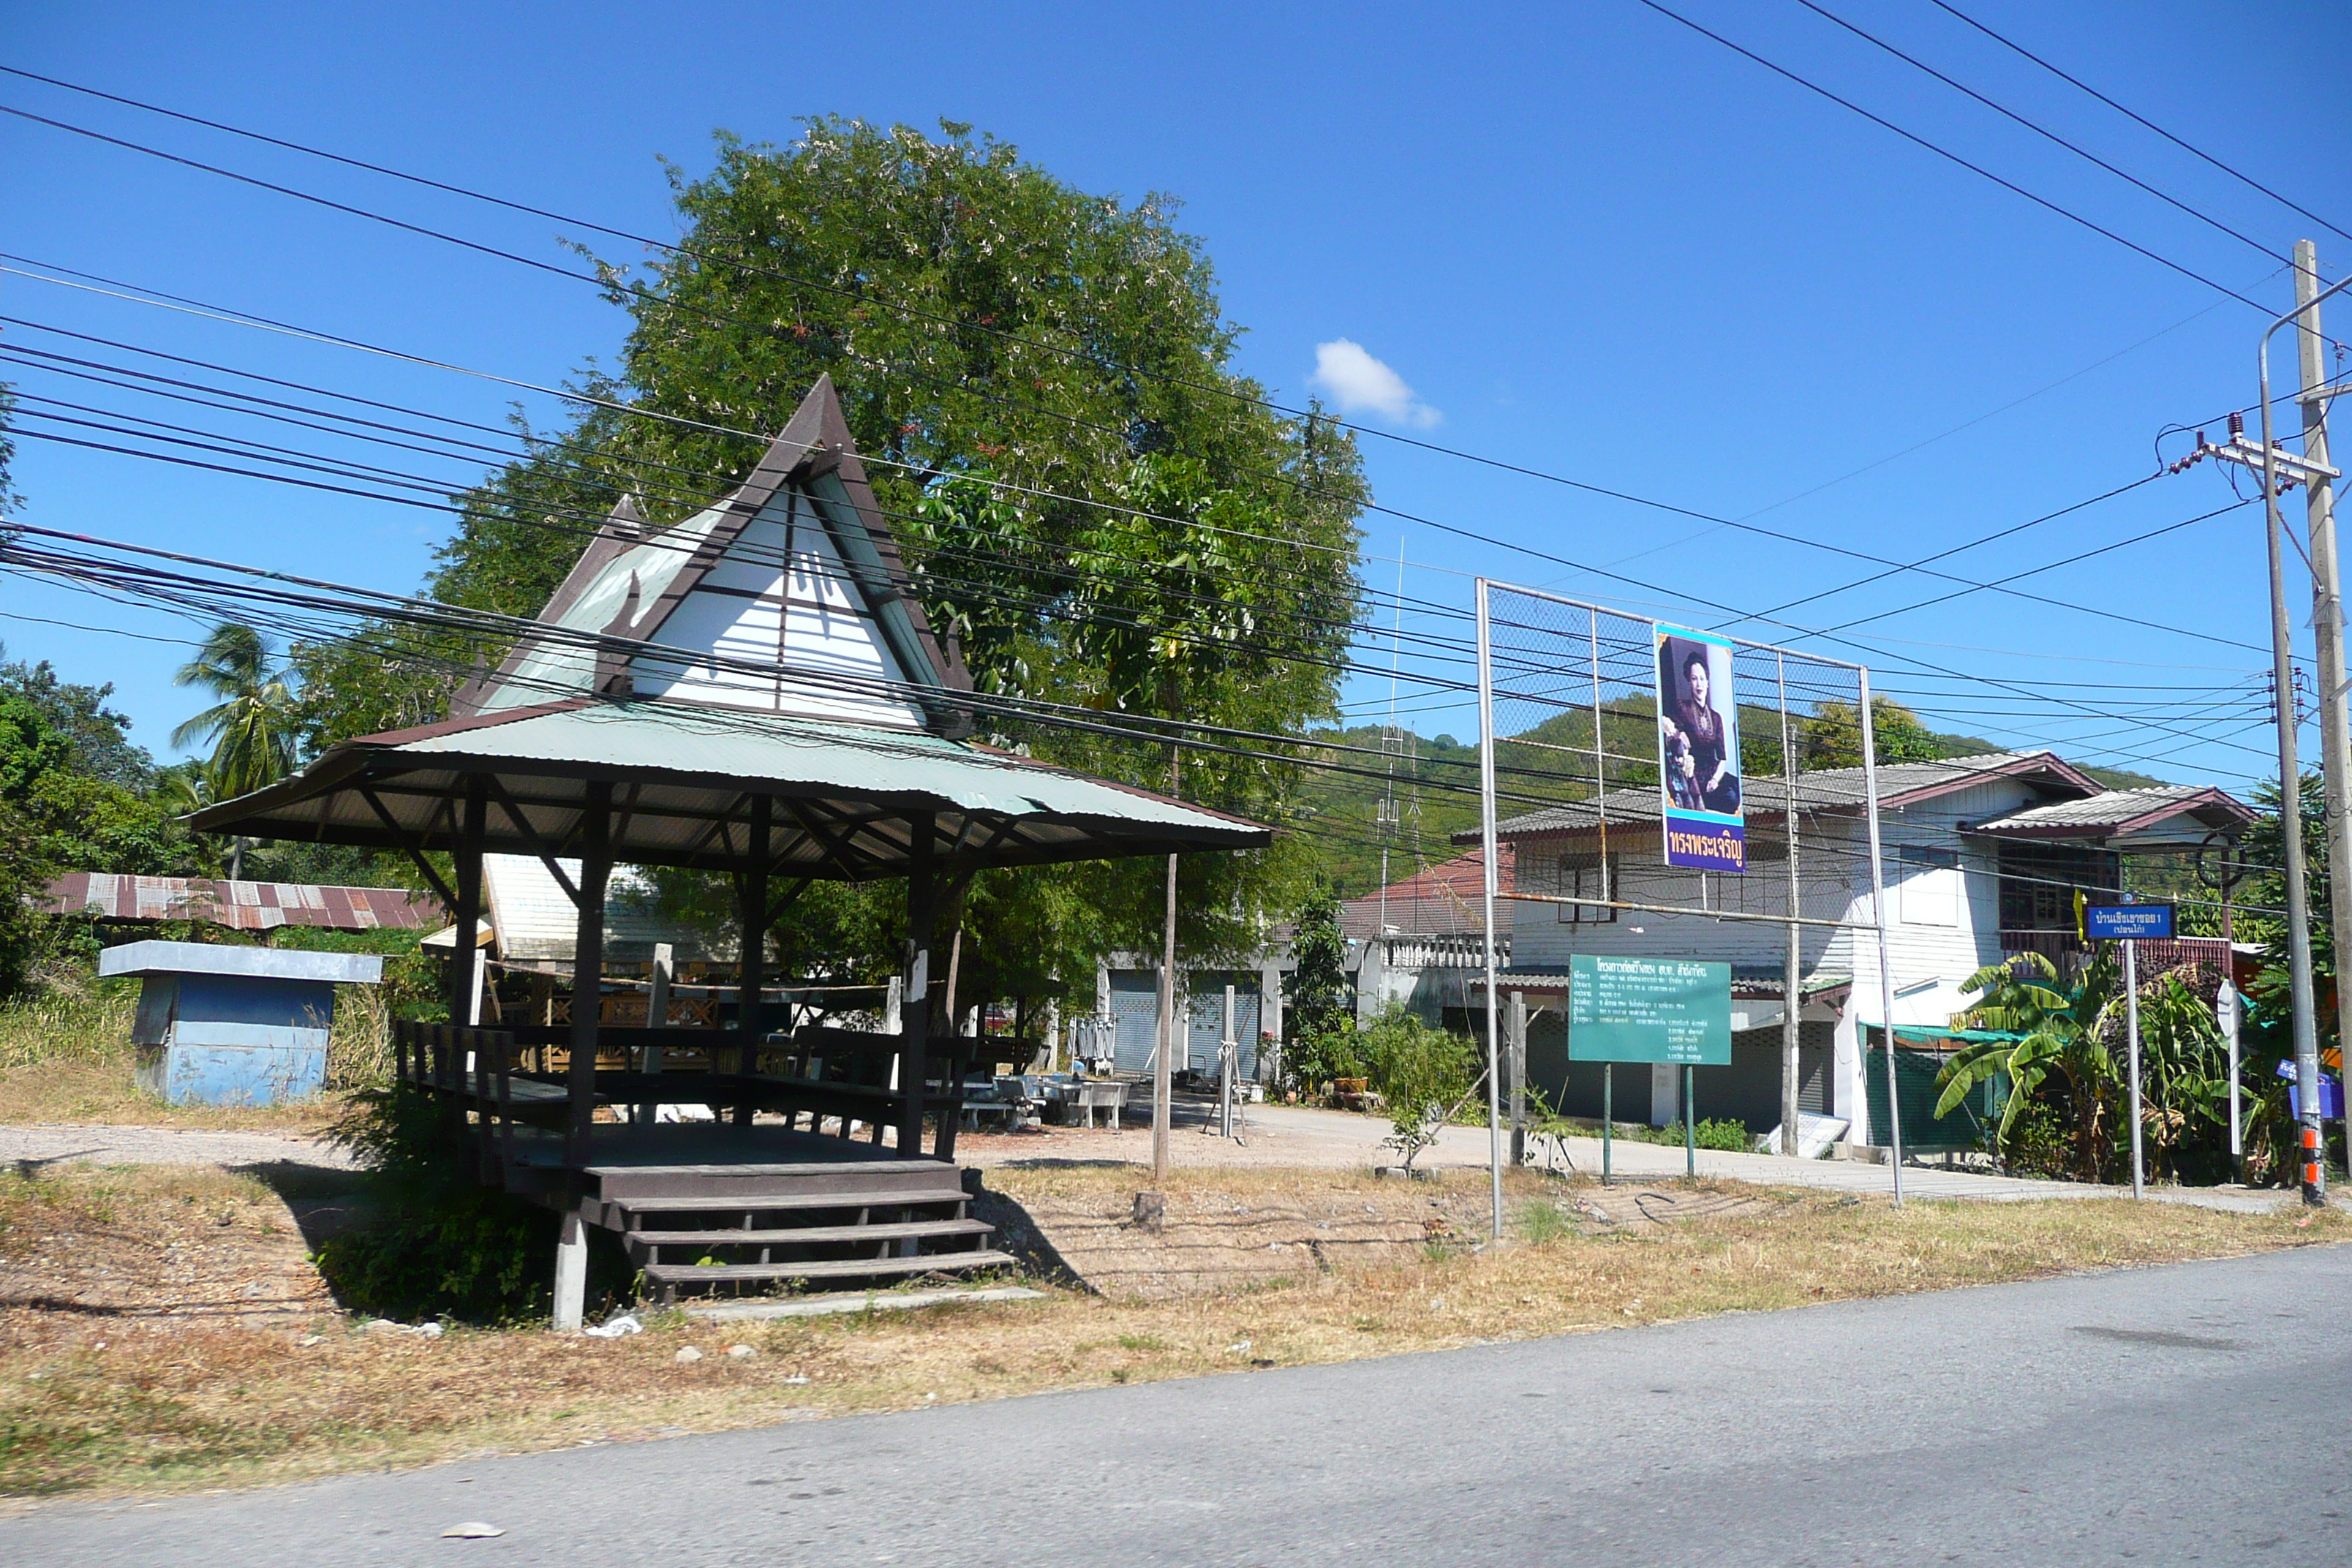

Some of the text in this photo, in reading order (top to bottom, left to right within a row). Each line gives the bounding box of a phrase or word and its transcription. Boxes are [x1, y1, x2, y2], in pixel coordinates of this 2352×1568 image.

[1669, 829, 1743, 867] ทรงพระเจริญ
[2157, 914, 2161, 924] 1
